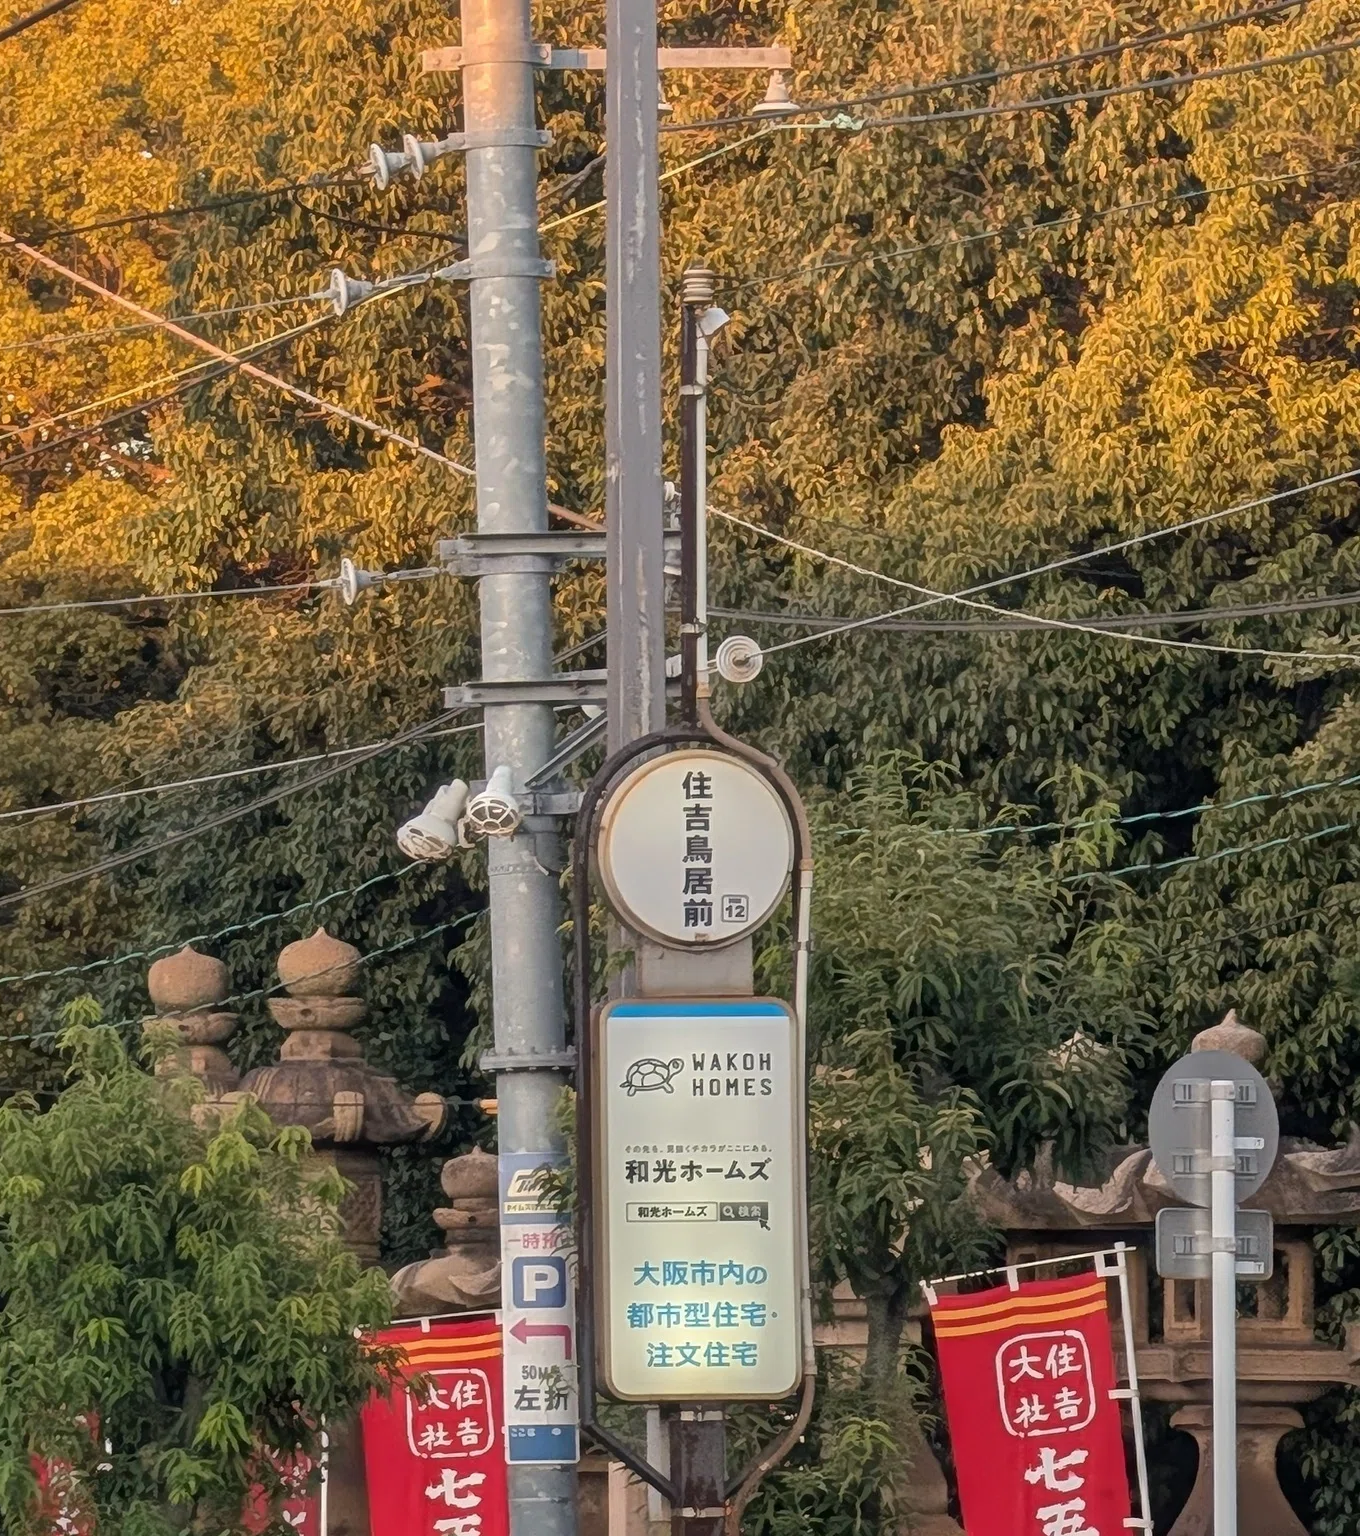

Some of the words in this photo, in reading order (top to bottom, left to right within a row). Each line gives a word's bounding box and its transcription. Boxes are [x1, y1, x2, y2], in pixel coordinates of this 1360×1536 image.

[682, 771, 713, 927] 住吉鳥居前
[725, 904, 745, 918] 12
[691, 1052, 771, 1071] WAKOH
[691, 1077, 772, 1097] HOMES
[625, 1157, 772, 1184] 和光ホームズ
[523, 1265, 559, 1301] P
[633, 1260, 768, 1286] 大阪市内の
[646, 1341, 758, 1367] 注文住宅
